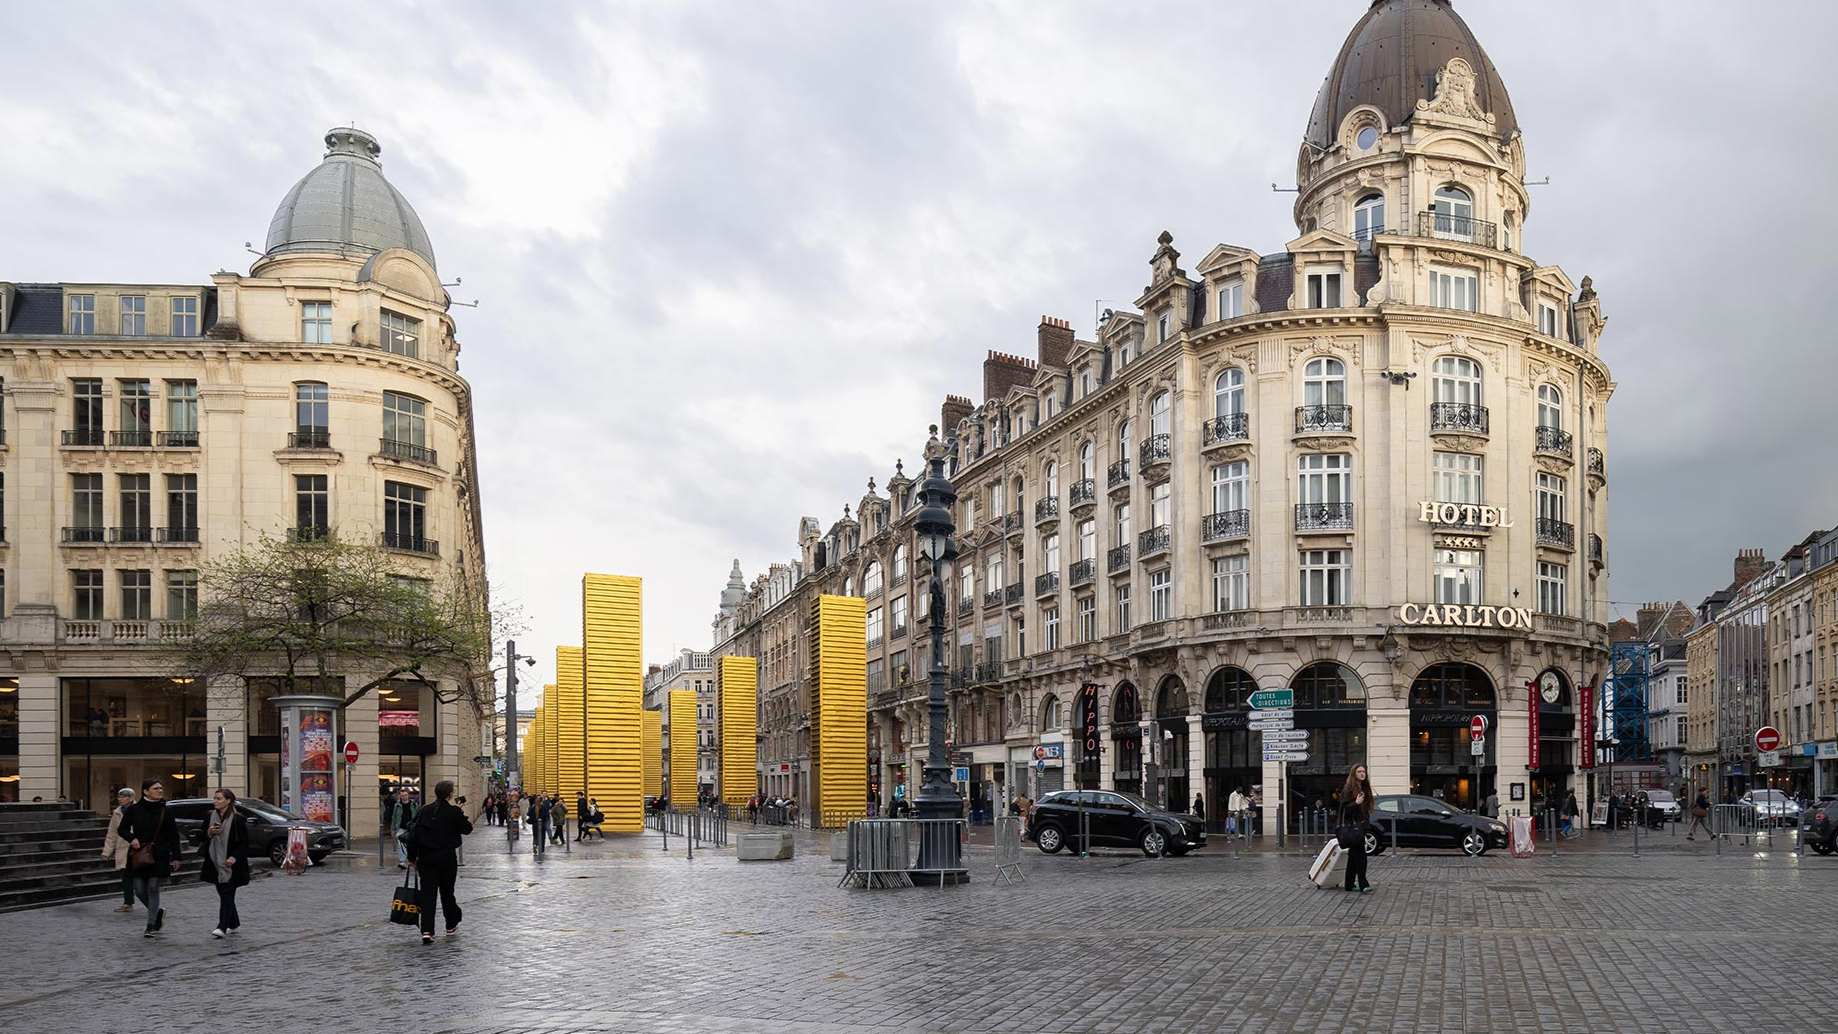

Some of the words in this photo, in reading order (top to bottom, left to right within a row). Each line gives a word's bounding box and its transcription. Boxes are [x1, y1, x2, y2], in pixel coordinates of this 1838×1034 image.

[1417, 500, 1515, 528] HOTEL
[1399, 602, 1534, 628] CARLTON
[1085, 686, 1096, 751] HIPPO
